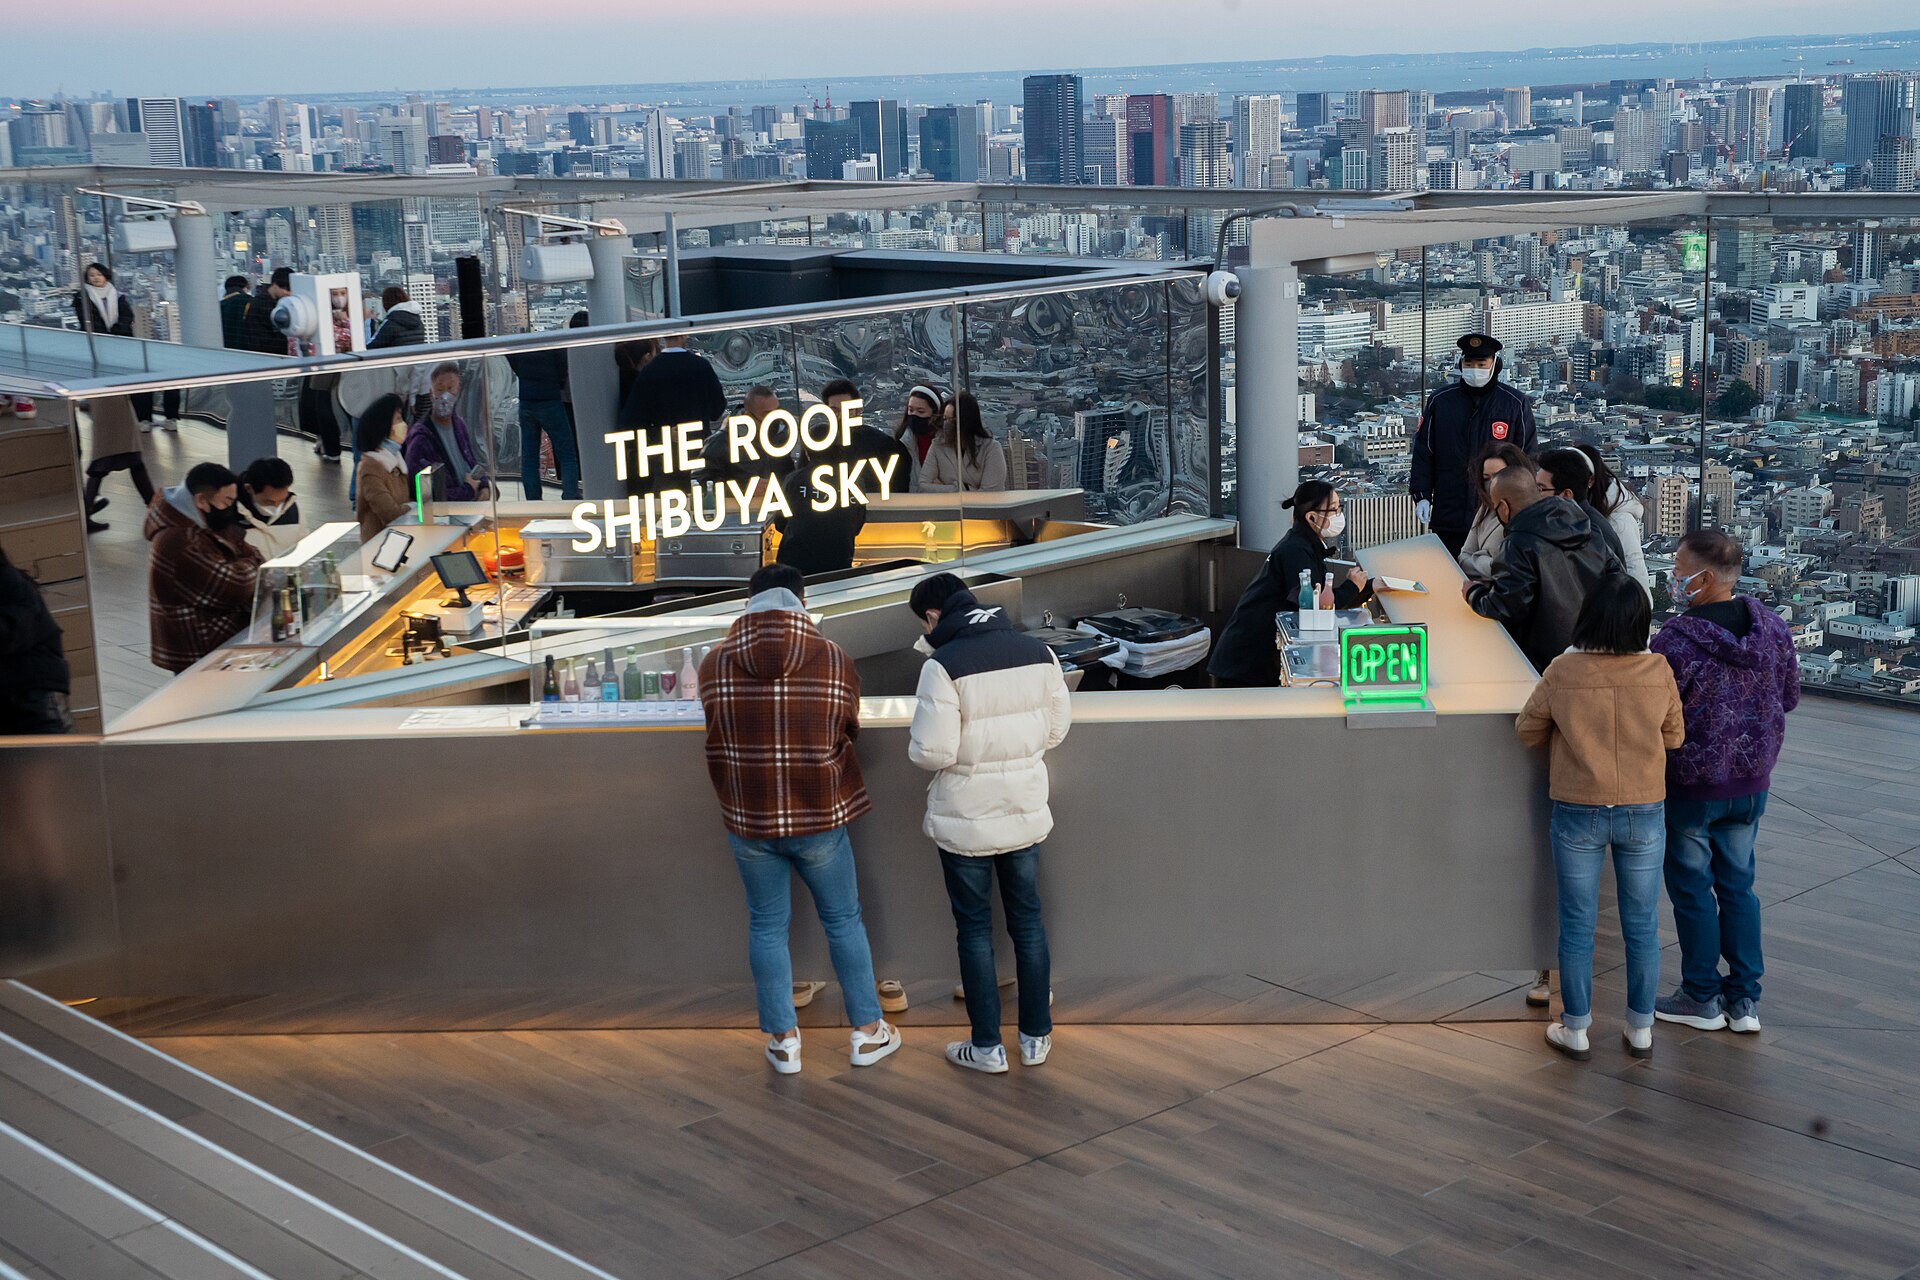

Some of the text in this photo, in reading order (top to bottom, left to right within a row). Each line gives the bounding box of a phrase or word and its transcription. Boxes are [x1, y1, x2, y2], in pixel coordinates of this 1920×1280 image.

[605, 398, 864, 481] THE ROOF
[571, 453, 900, 553] SHIBUYA SKY
[1351, 643, 1418, 683] OPEN
